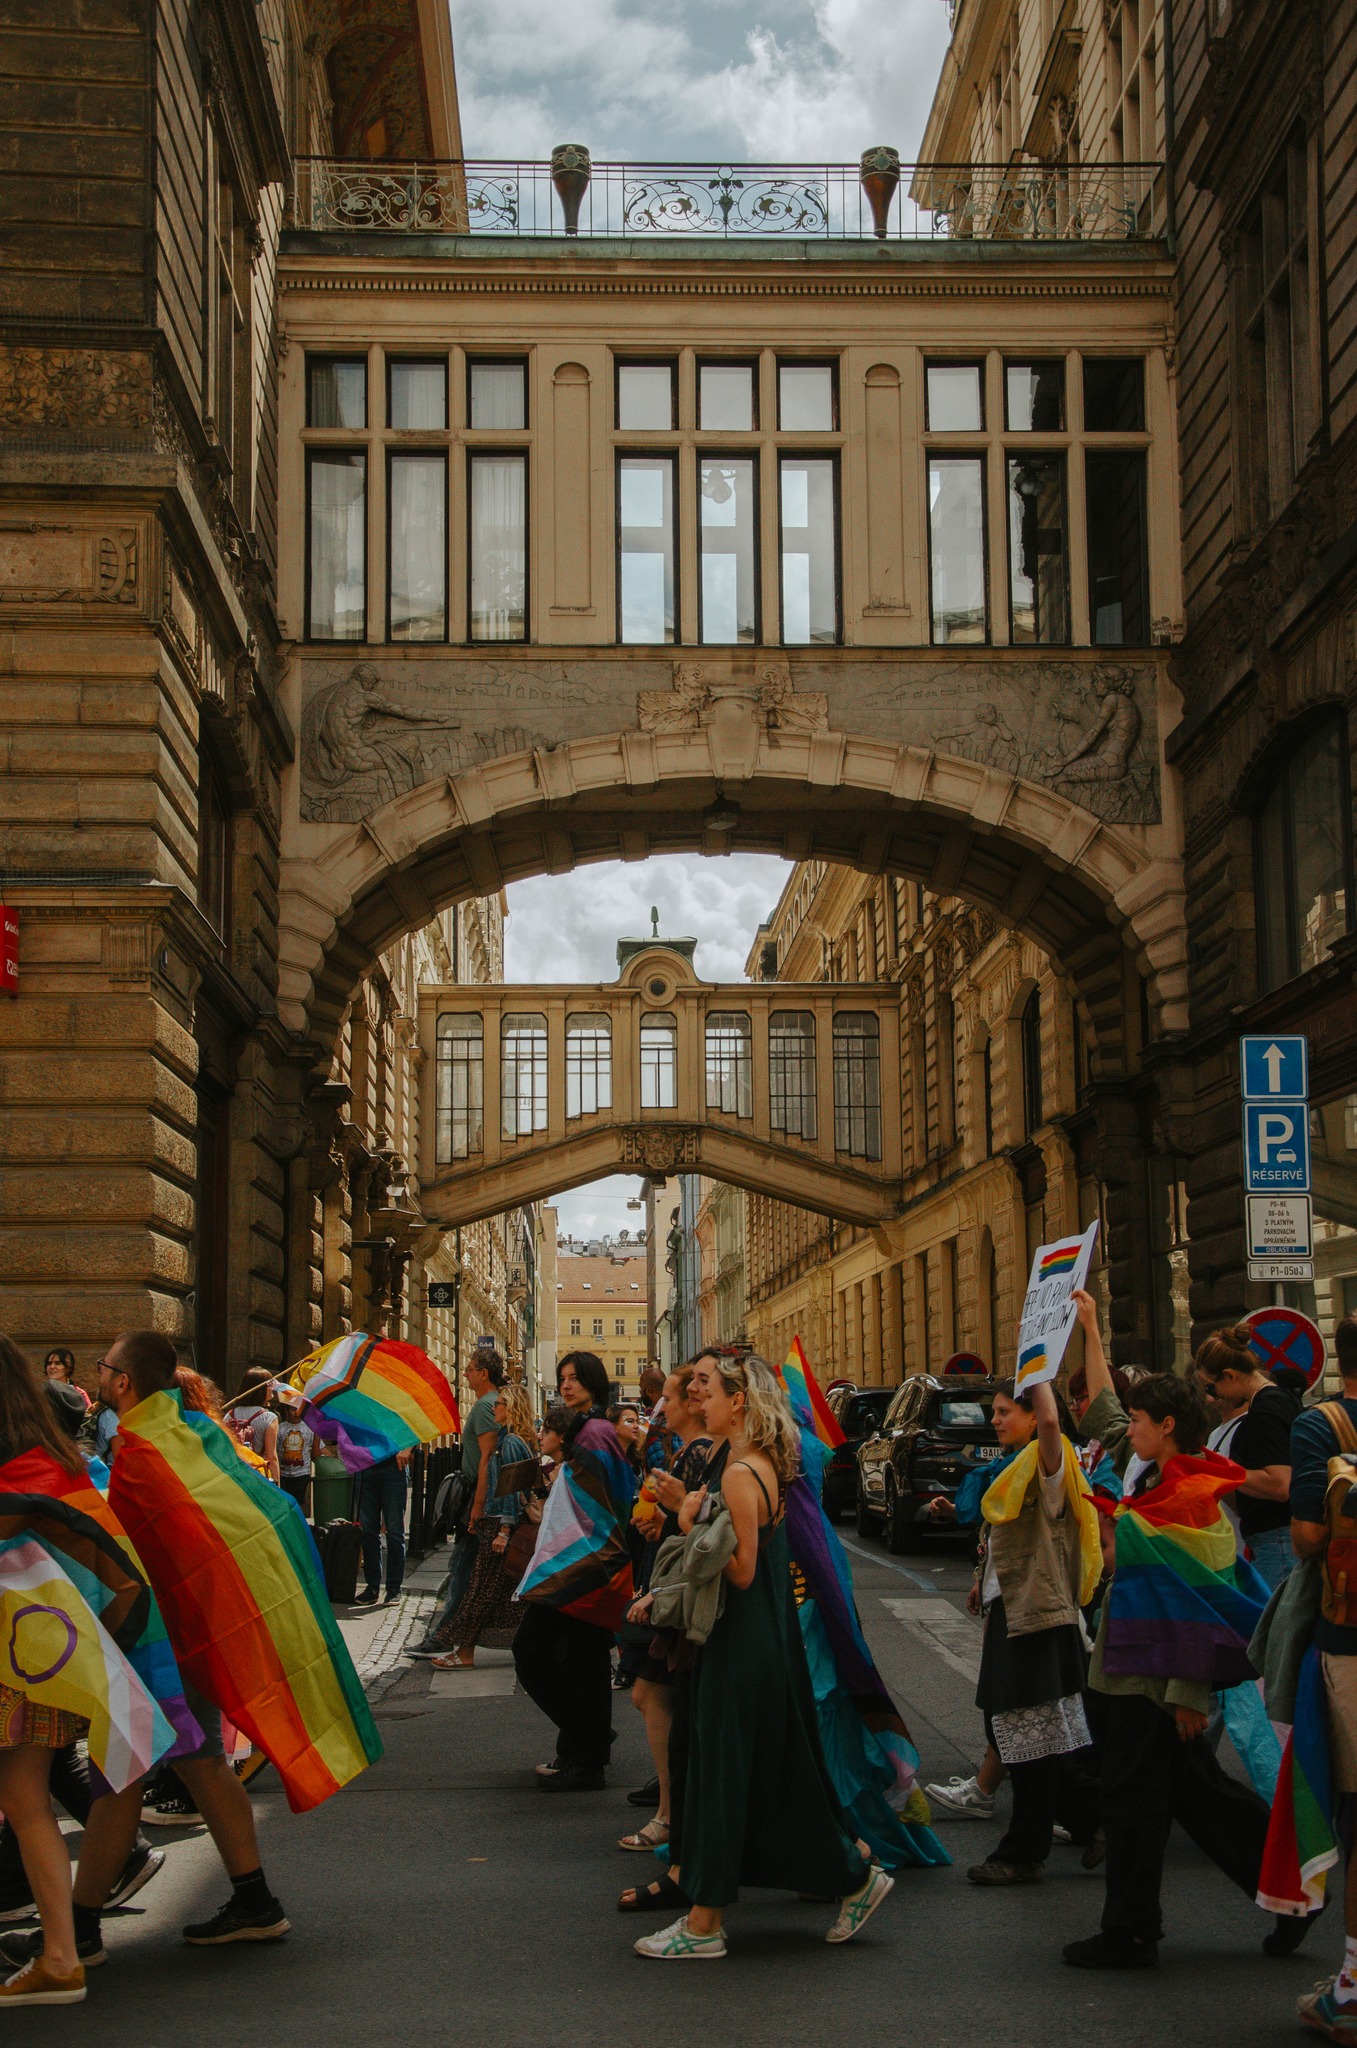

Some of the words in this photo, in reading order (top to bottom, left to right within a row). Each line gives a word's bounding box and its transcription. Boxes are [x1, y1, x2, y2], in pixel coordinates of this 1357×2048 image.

[1258, 1114, 1294, 1163] P
[1252, 1167, 1304, 1180] RÉSERVÉ
[1269, 1200, 1287, 1208] PO-NE
[1270, 1218, 1294, 1226] PLATNÝM
[1263, 1227, 1296, 1235] PARKOVACÍM
